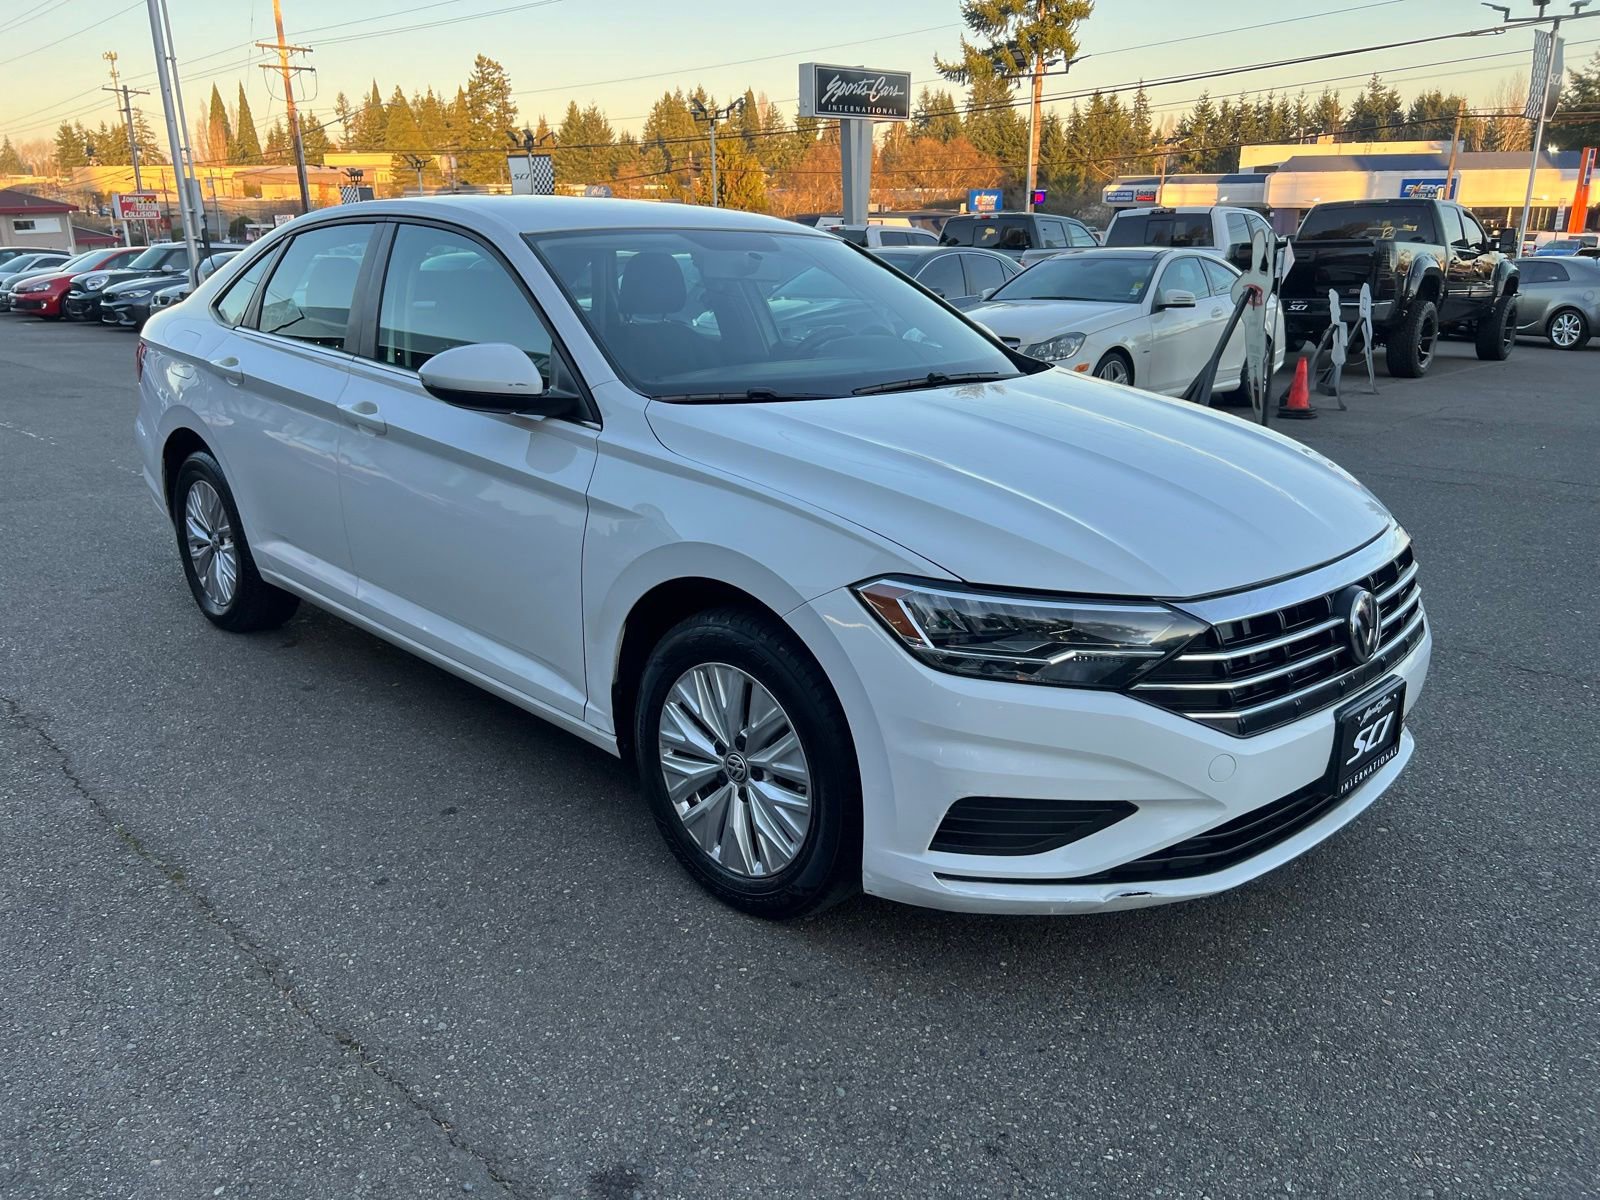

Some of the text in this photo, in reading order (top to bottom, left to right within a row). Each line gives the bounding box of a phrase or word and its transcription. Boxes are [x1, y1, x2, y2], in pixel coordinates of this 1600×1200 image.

[821, 74, 904, 104] Sports Cars
[828, 104, 898, 115] INTERNATIONAL
[123, 210, 157, 218] COLLISION
[1345, 710, 1395, 766] SCI
[1340, 746, 1399, 794] INTERNATIONAL
